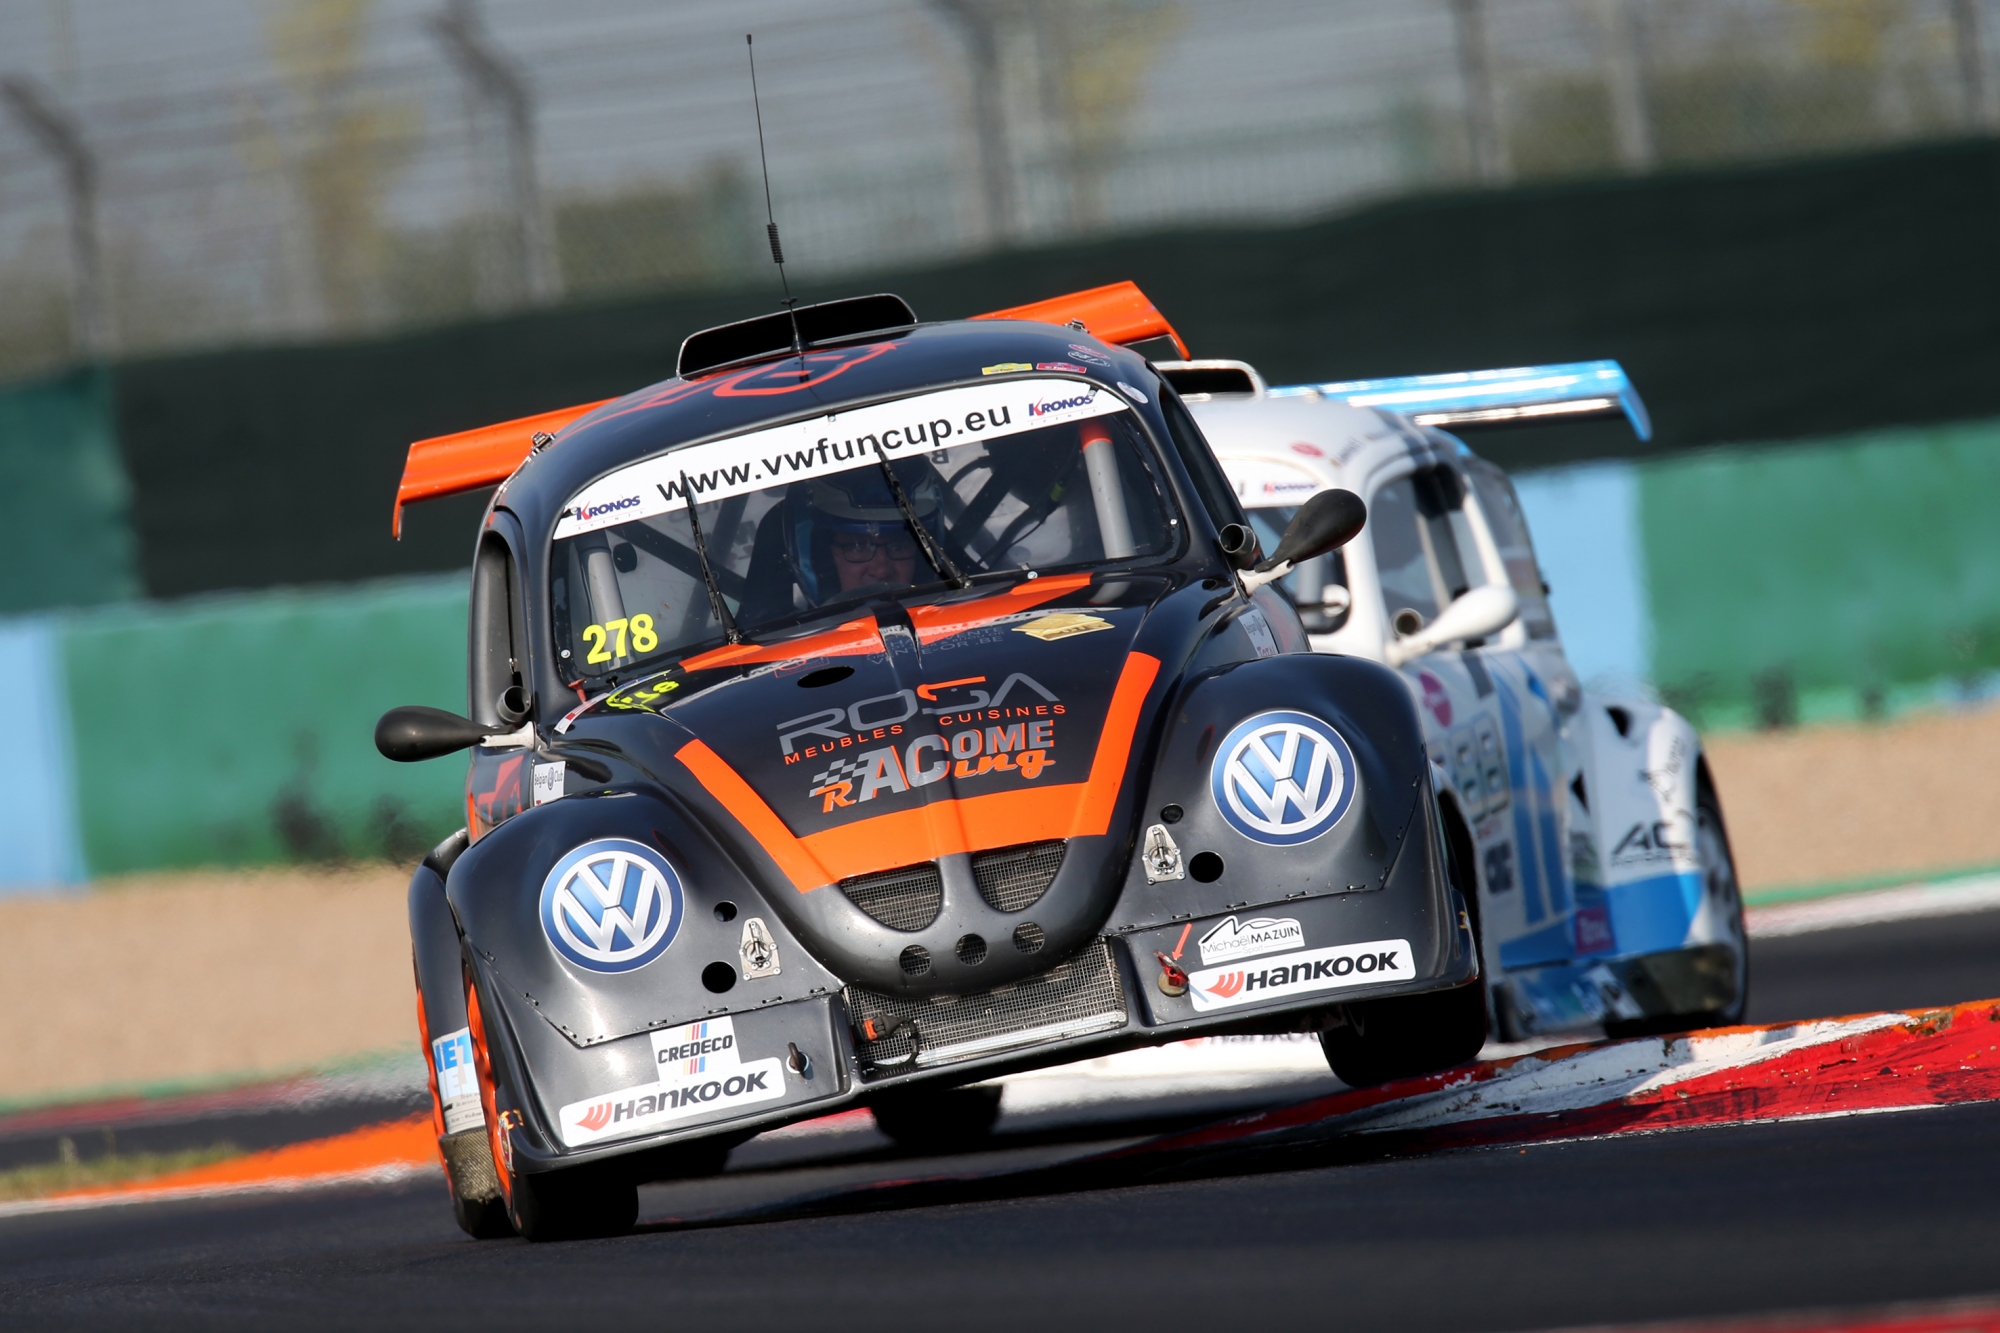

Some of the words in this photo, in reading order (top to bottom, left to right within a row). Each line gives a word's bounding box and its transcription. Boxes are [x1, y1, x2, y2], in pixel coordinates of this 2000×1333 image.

[1029, 393, 1094, 417] KRONOS
[656, 405, 1012, 501] www.vwfuncup.eu
[575, 494, 641, 520] KRONOS
[582, 613, 659, 665] 278
[776, 672, 1061, 756] ROSA
[784, 724, 904, 766] MEUBLES
[938, 704, 1067, 727] CUISINES
[657, 1034, 734, 1064] CREDECO
